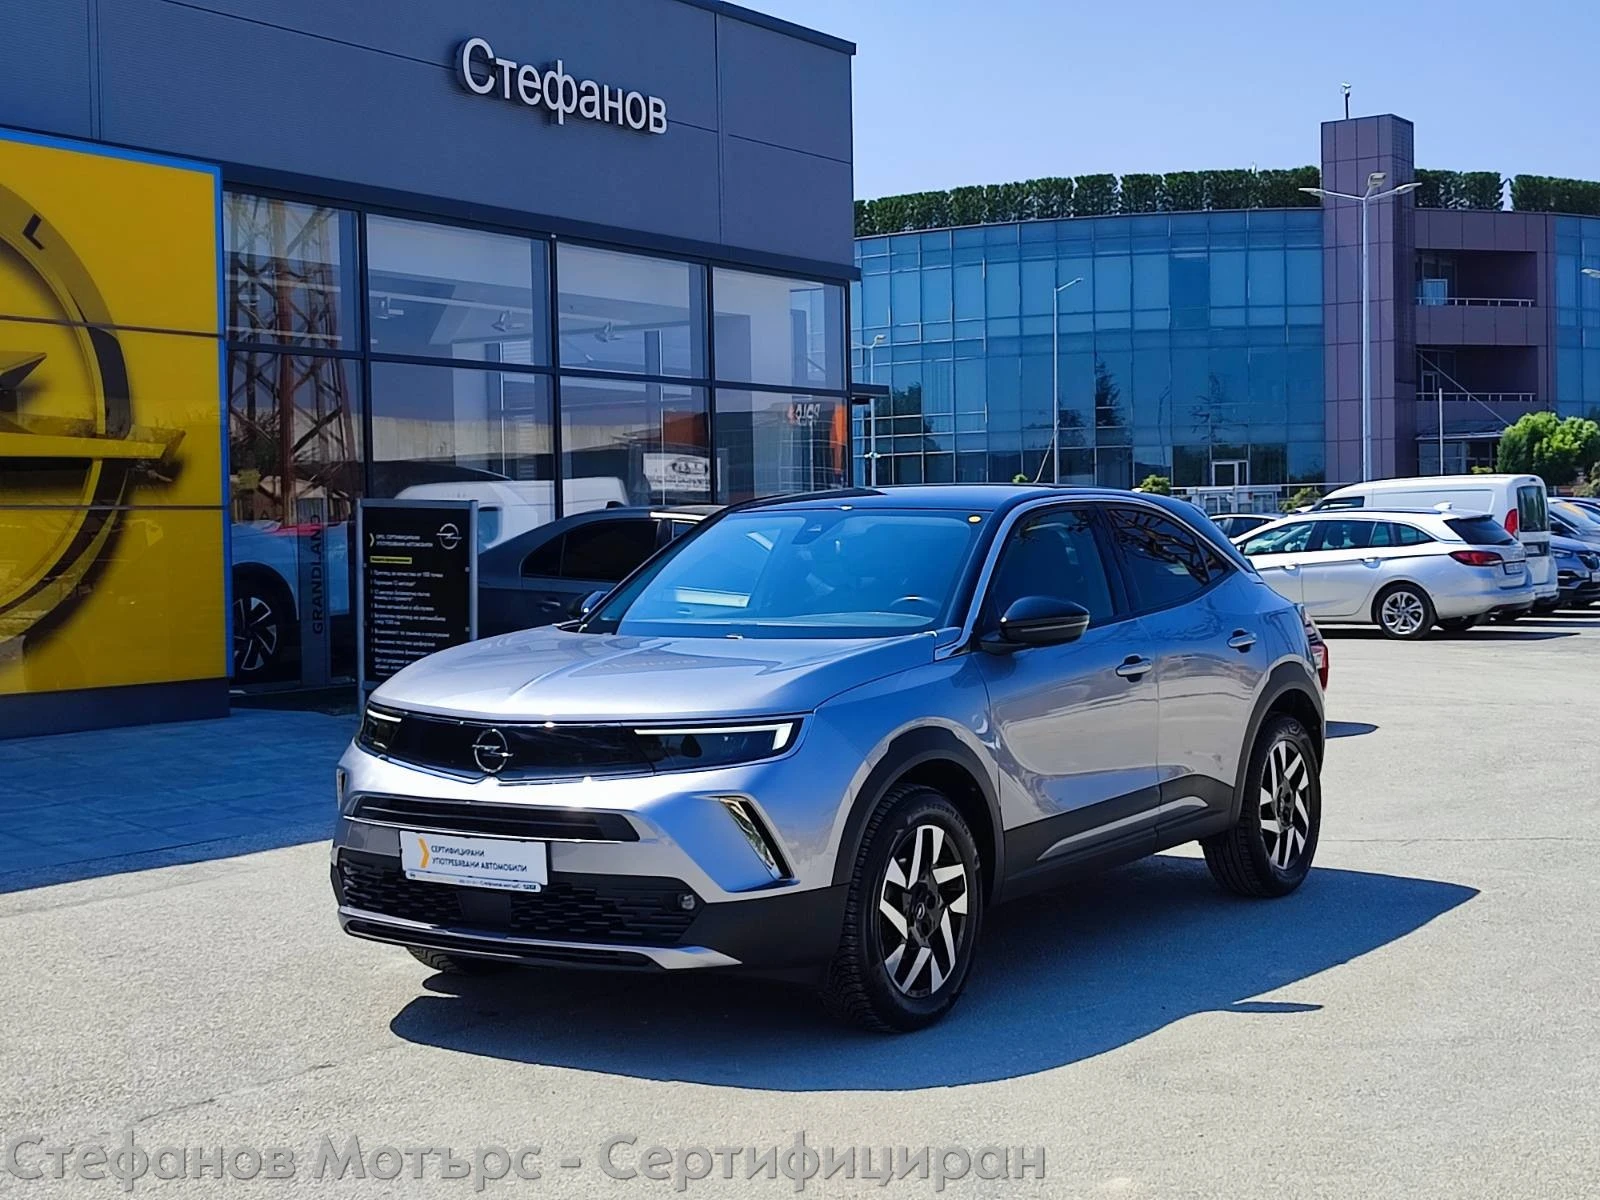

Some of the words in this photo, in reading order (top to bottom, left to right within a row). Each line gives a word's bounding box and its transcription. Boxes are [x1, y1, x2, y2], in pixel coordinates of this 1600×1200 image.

[461, 37, 668, 135] Стефанов
[312, 513, 324, 635] GRANDLAND
[430, 845, 485, 857] СЕРТИФИЦИРАНИ
[432, 857, 480, 868] УПОТРЕБЯВАНИ
[480, 862, 528, 873] АВТОМОБИЛИ
